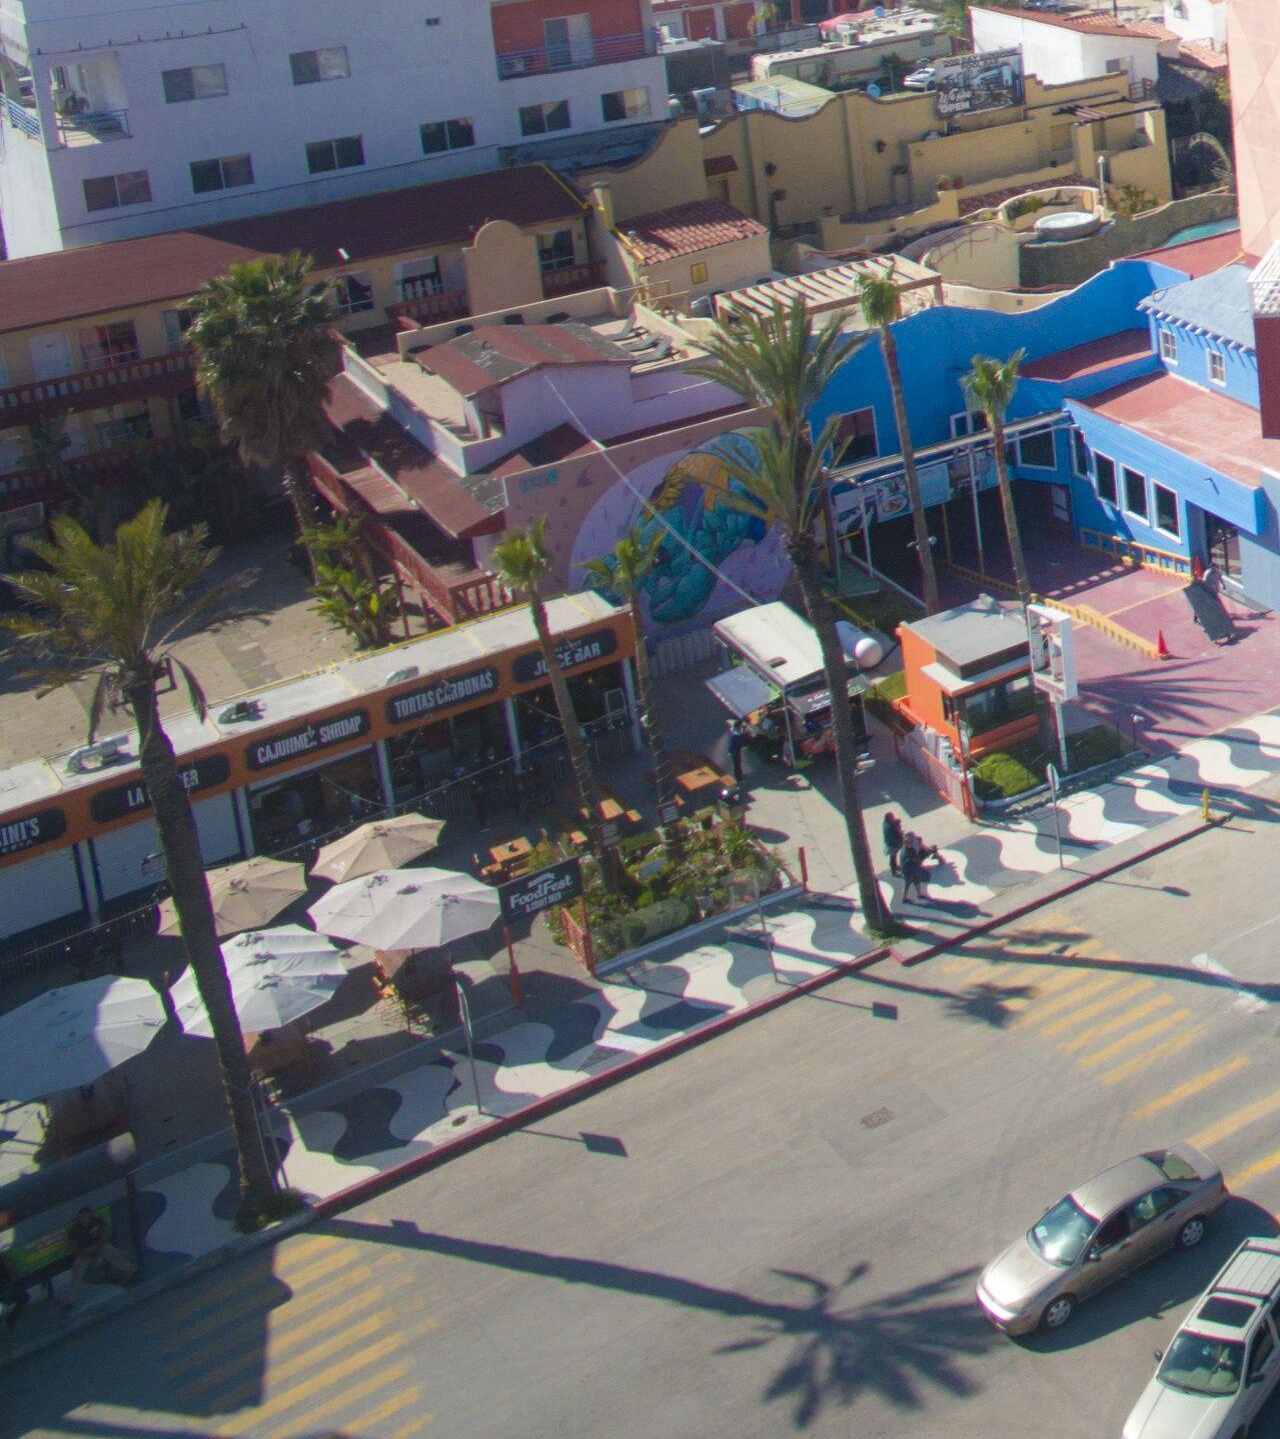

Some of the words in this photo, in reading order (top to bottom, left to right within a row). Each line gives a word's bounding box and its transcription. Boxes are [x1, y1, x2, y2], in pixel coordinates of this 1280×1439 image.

[533, 651, 574, 676] JUCE
[574, 642, 601, 663] BAR
[394, 689, 435, 717] TORTAS
[319, 715, 362, 743] SHRIMP
[0, 817, 40, 847] INI'S
[510, 874, 573, 910] FoodFest
